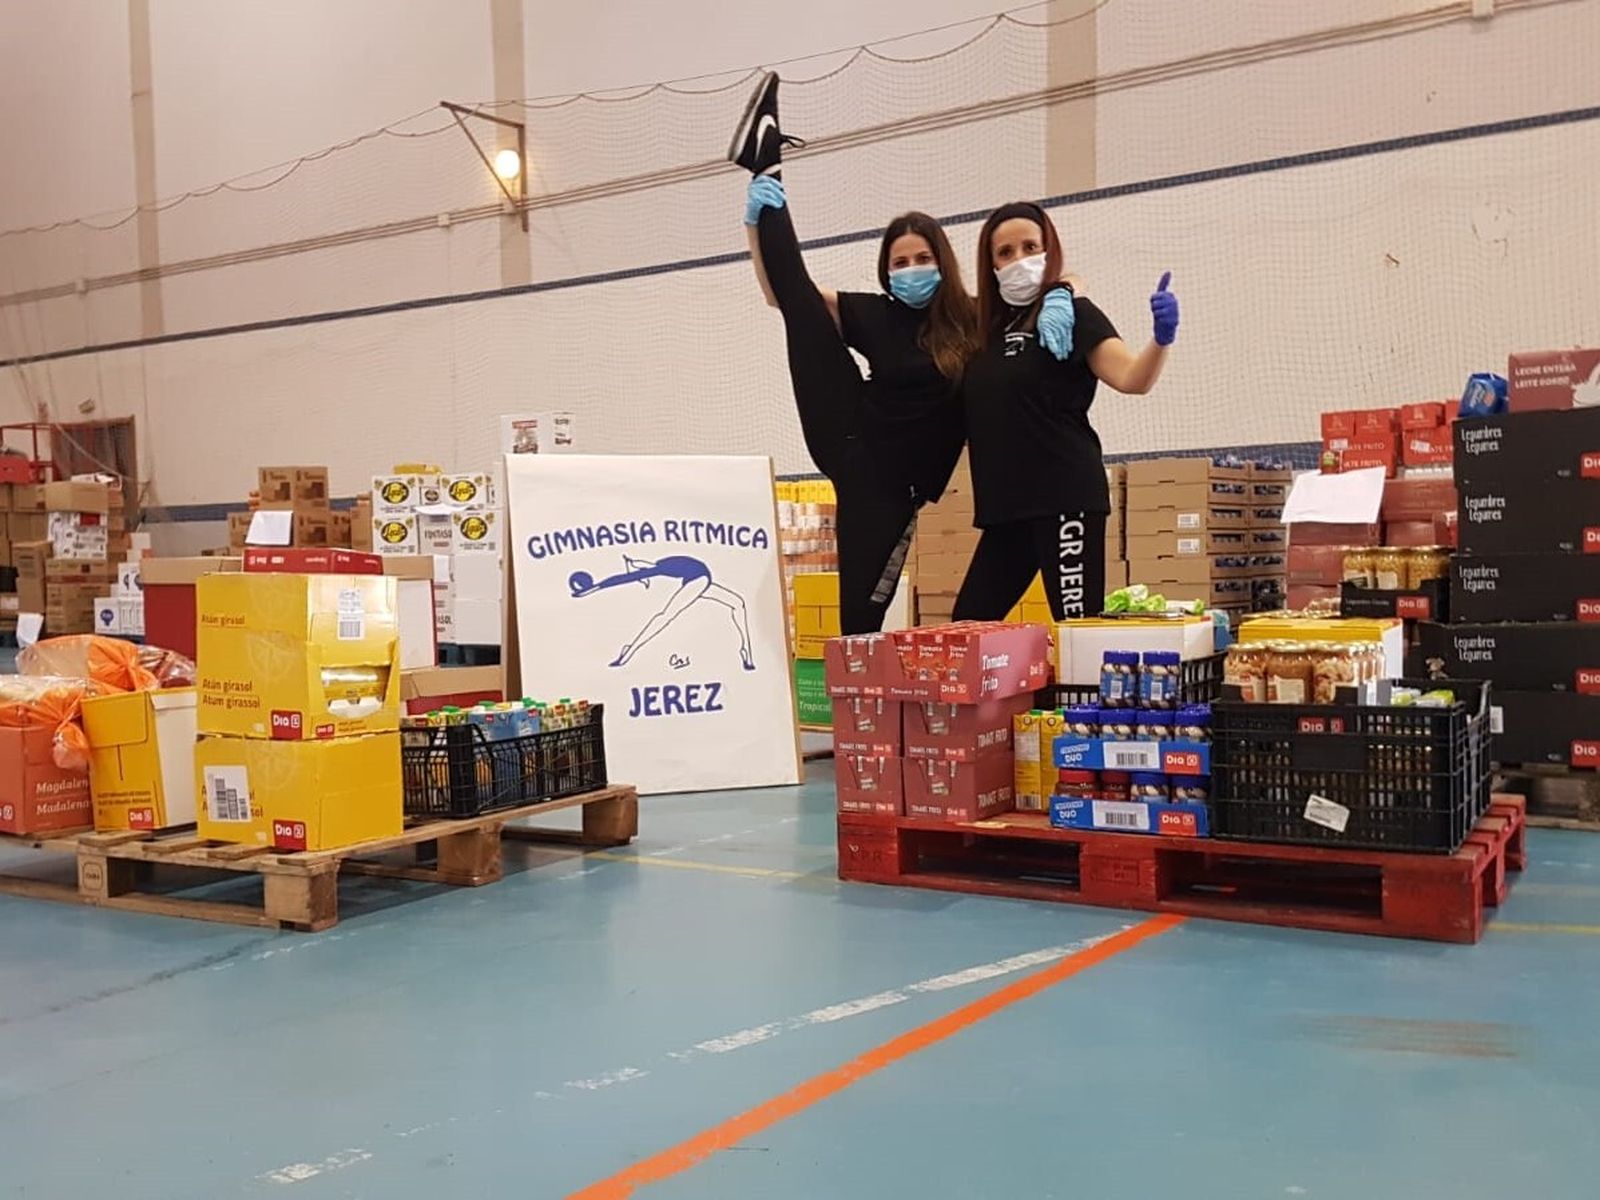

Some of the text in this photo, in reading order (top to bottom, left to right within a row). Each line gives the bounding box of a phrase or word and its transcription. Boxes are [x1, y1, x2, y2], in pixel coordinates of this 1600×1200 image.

[1514, 366, 1541, 377] LECHE
[527, 520, 769, 559] GIMNASIA RITMICA
[1059, 512, 1084, 620] GR JERE
[223, 680, 252, 694] girasol
[941, 684, 956, 693] Dia
[226, 696, 260, 709] girassol
[629, 683, 723, 718] JEREZ
[273, 714, 289, 726] Dia
[1301, 721, 1324, 732] Dia
[1573, 744, 1597, 756] Dia
[1166, 754, 1185, 765] Dia
[36, 779, 88, 793] Magdalen
[1162, 814, 1180, 824] Dia
[275, 823, 292, 836] Dia
